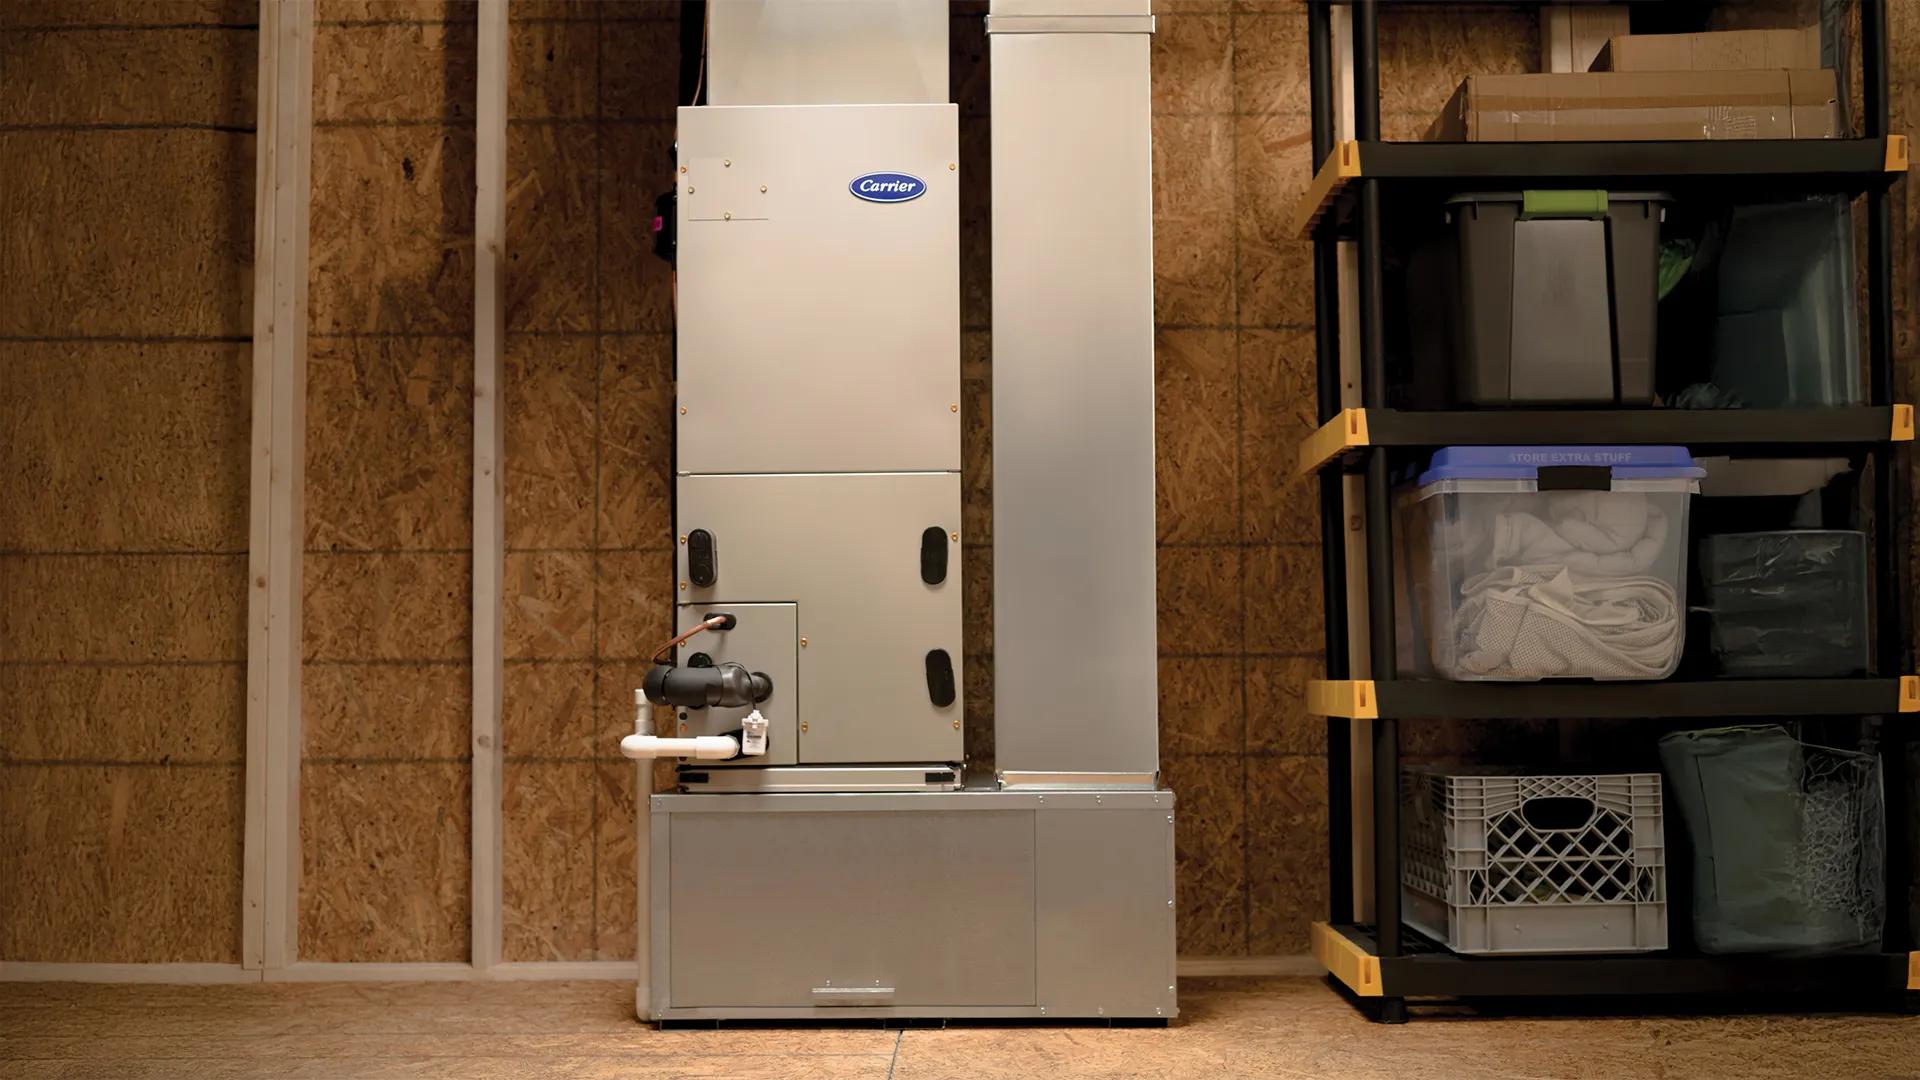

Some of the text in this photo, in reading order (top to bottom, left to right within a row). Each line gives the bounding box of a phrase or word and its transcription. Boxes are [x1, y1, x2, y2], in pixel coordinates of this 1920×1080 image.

[860, 179, 916, 192] Carrier
[1510, 452, 1632, 463] STORE EXTRA STUFF
